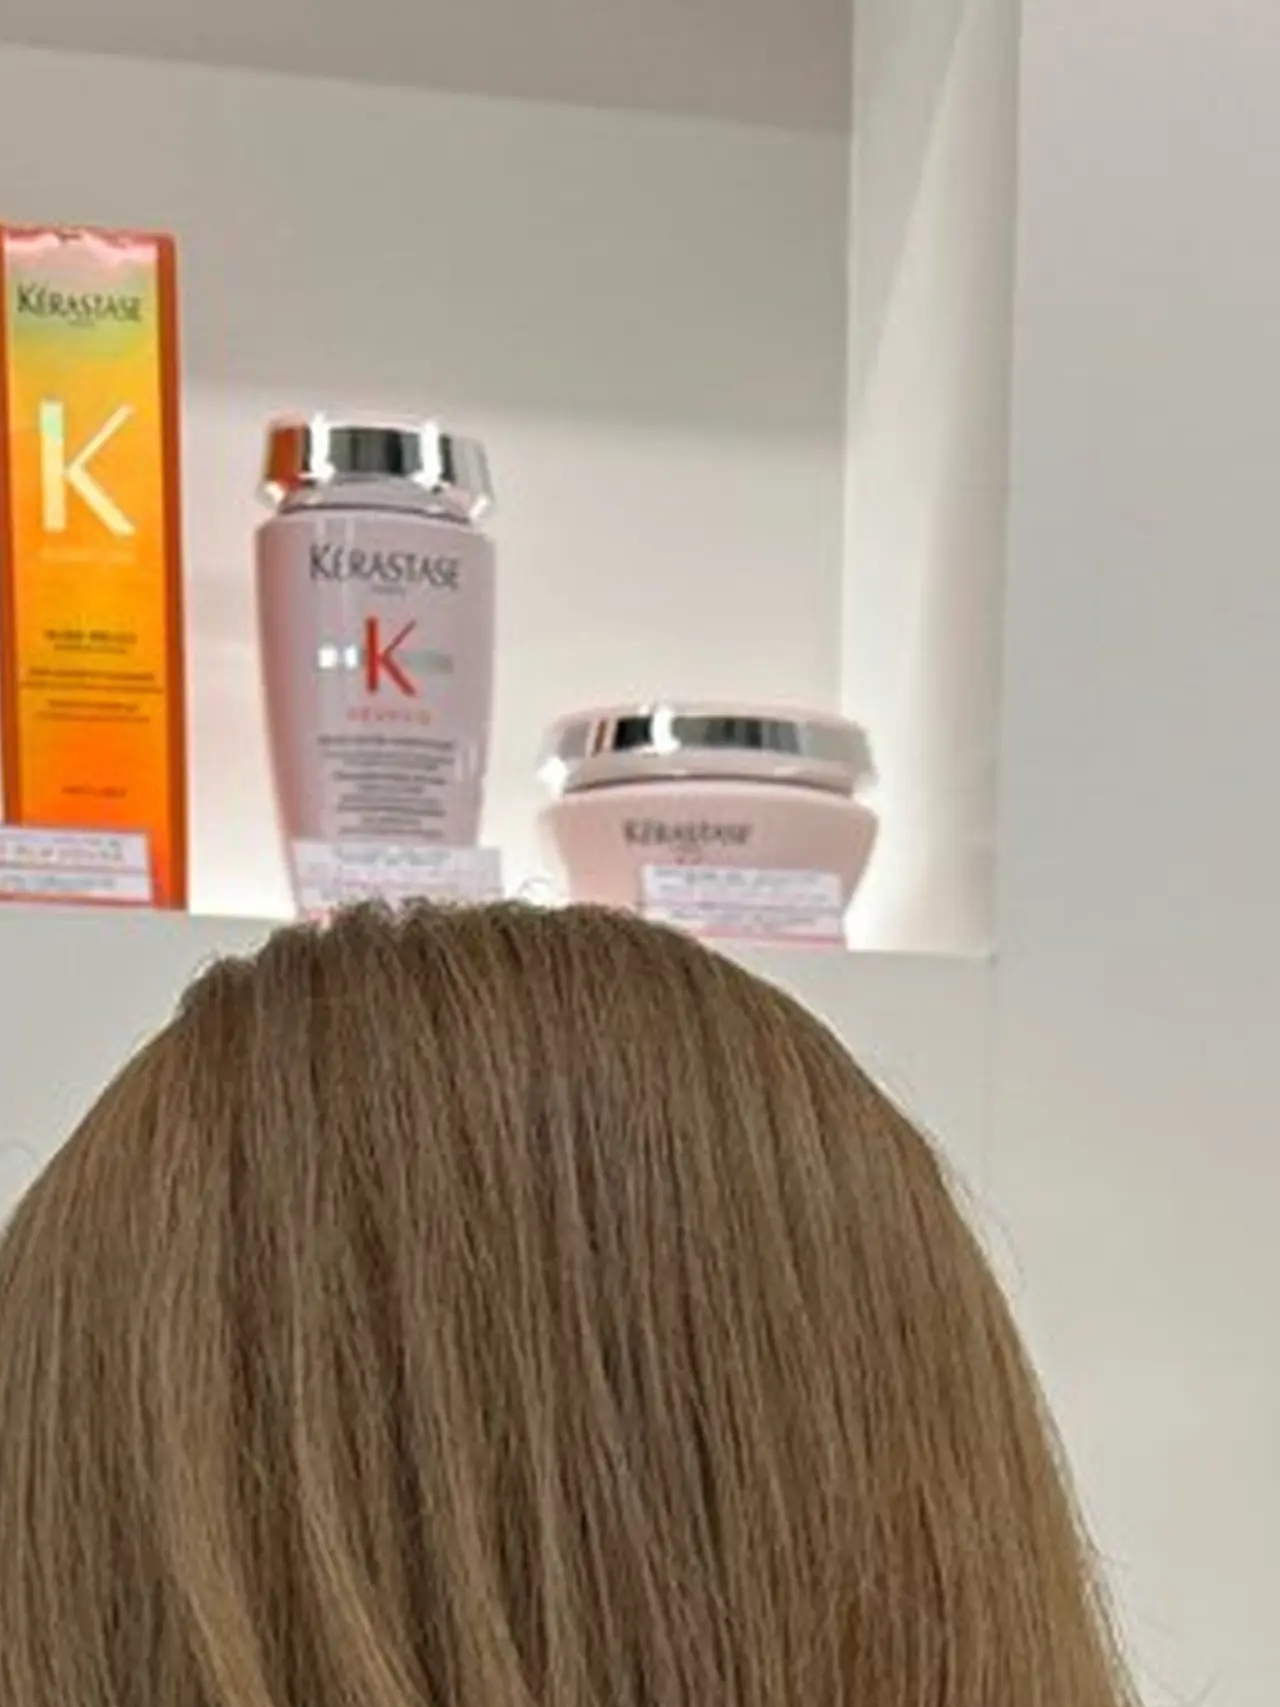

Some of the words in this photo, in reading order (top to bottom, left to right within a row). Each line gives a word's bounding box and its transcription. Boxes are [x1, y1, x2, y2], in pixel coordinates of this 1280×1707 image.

[36, 400, 138, 538] K
[309, 543, 460, 590] KÉRASTASE
[363, 614, 418, 697] K
